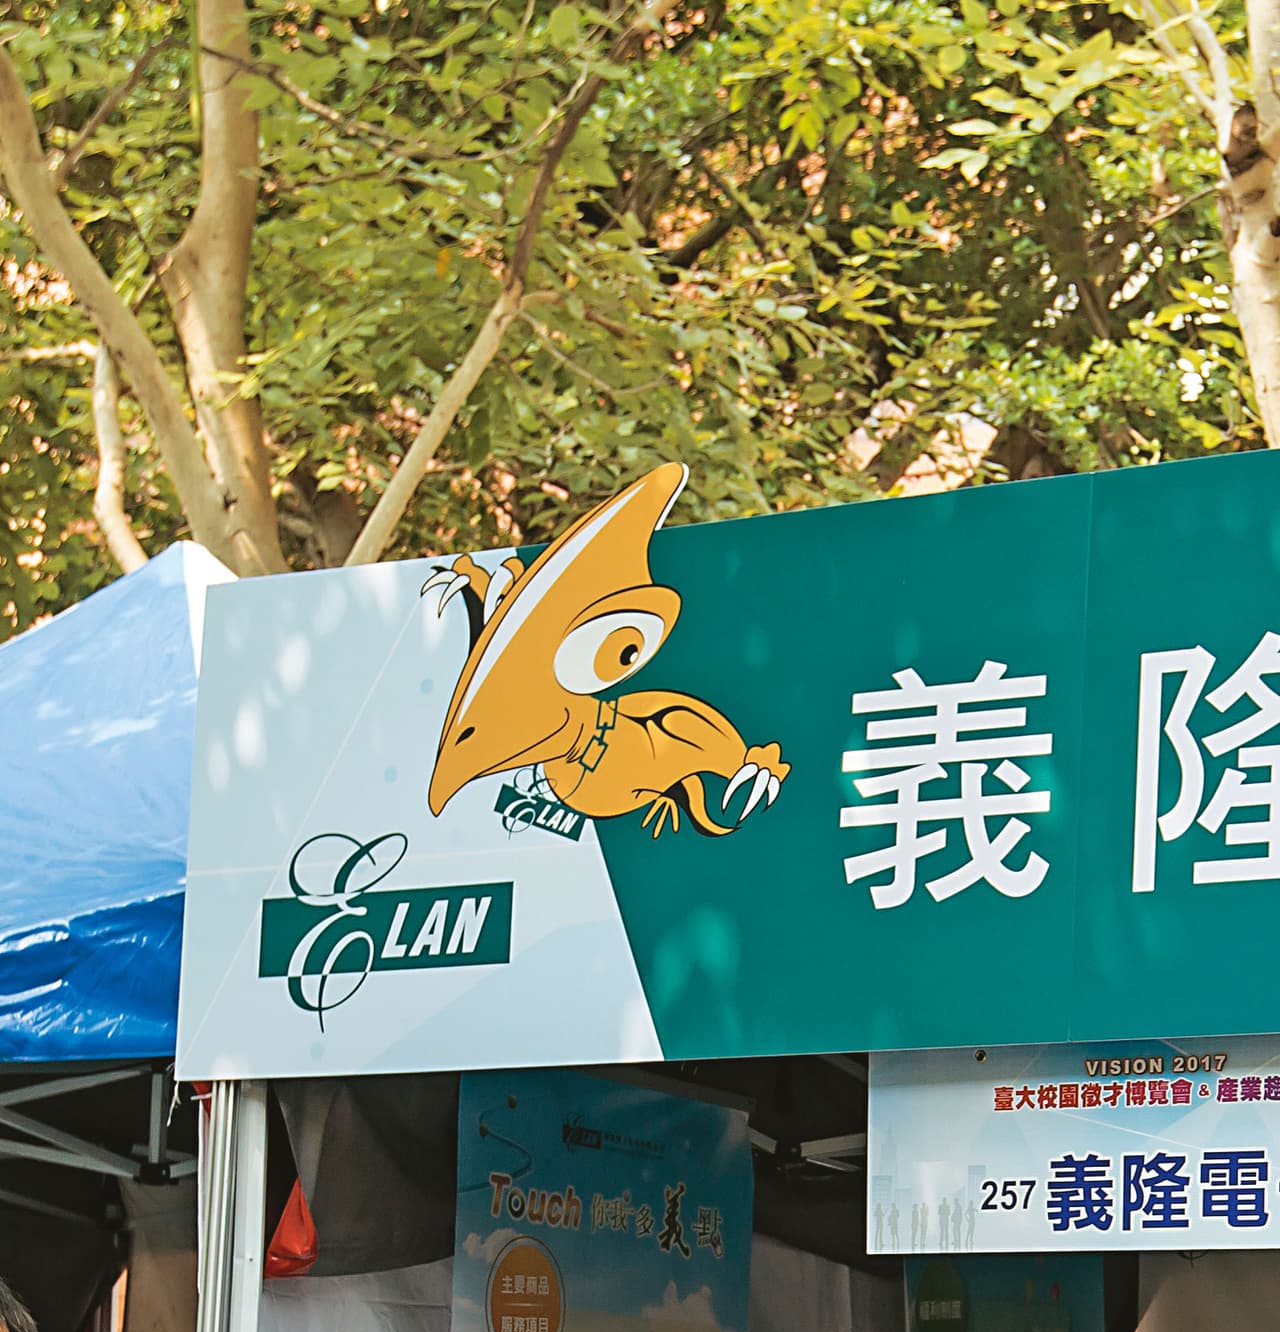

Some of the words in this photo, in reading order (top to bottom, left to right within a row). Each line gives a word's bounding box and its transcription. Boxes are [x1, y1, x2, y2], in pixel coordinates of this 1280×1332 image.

[501, 767, 579, 841] ELAN
[287, 832, 493, 1034] ELAN
[1085, 1057, 1163, 1077] VISION
[1172, 1053, 1228, 1074] 2017
[993, 1079, 1194, 1112] 臺大校園徵才博覽會
[1198, 1083, 1210, 1098] &
[488, 1171, 583, 1230] Touch
[980, 1179, 1037, 1211] 257
[501, 1274, 550, 1296] 主要商品
